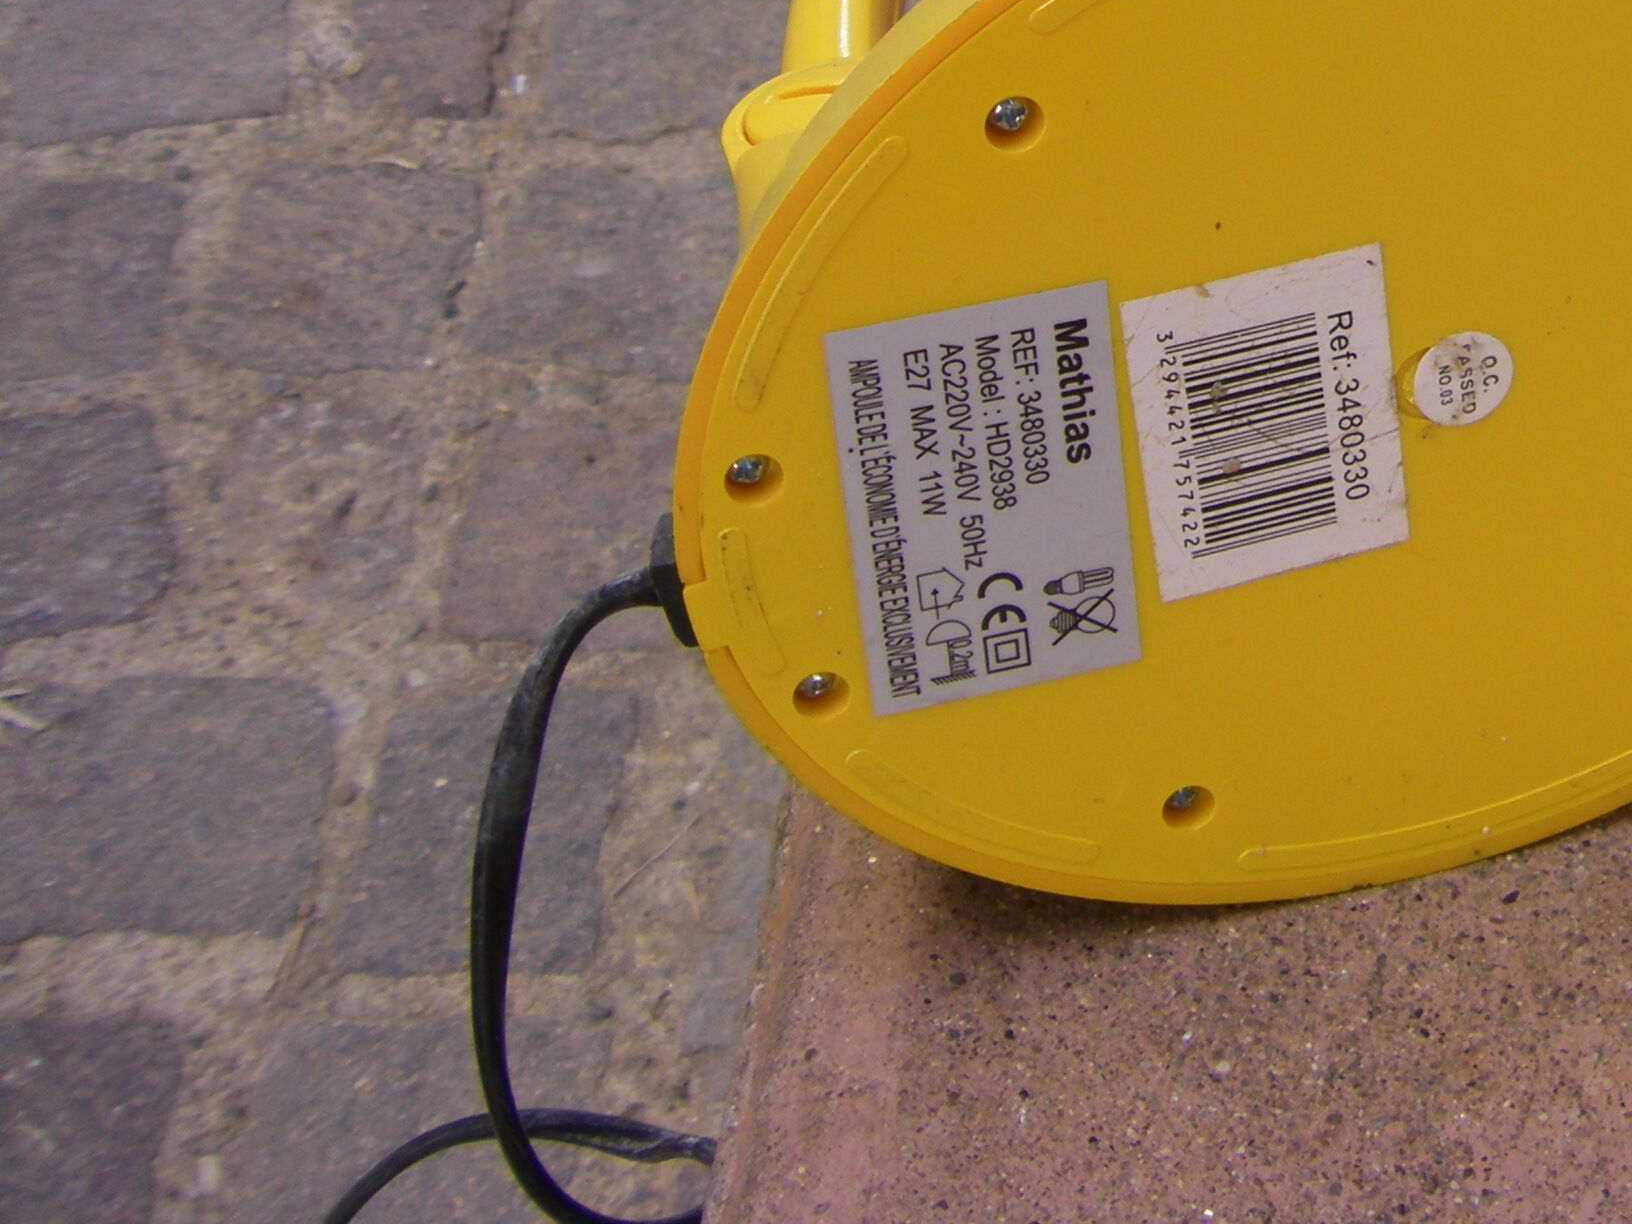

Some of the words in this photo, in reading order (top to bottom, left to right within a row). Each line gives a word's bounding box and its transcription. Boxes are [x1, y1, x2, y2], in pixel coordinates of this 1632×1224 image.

[903, 348, 931, 392] E27
[975, 334, 1003, 401] Model
[1011, 327, 1039, 386] REF:
[1327, 310, 1355, 372] Ref:
[848, 359, 885, 424] AMPOULE
[939, 343, 981, 503] AC220V~240V
[1054, 318, 1092, 464] Mathias
[857, 423, 888, 445] DE
[909, 404, 939, 460] MAX
[1017, 391, 1050, 486] 3480330
[1334, 378, 1370, 502] 3480330
[917, 470, 947, 517] 11W
[985, 420, 1017, 511] HD2938
[959, 514, 988, 572] 50Hz
[879, 596, 921, 698] EXCLUSIVEMENT
